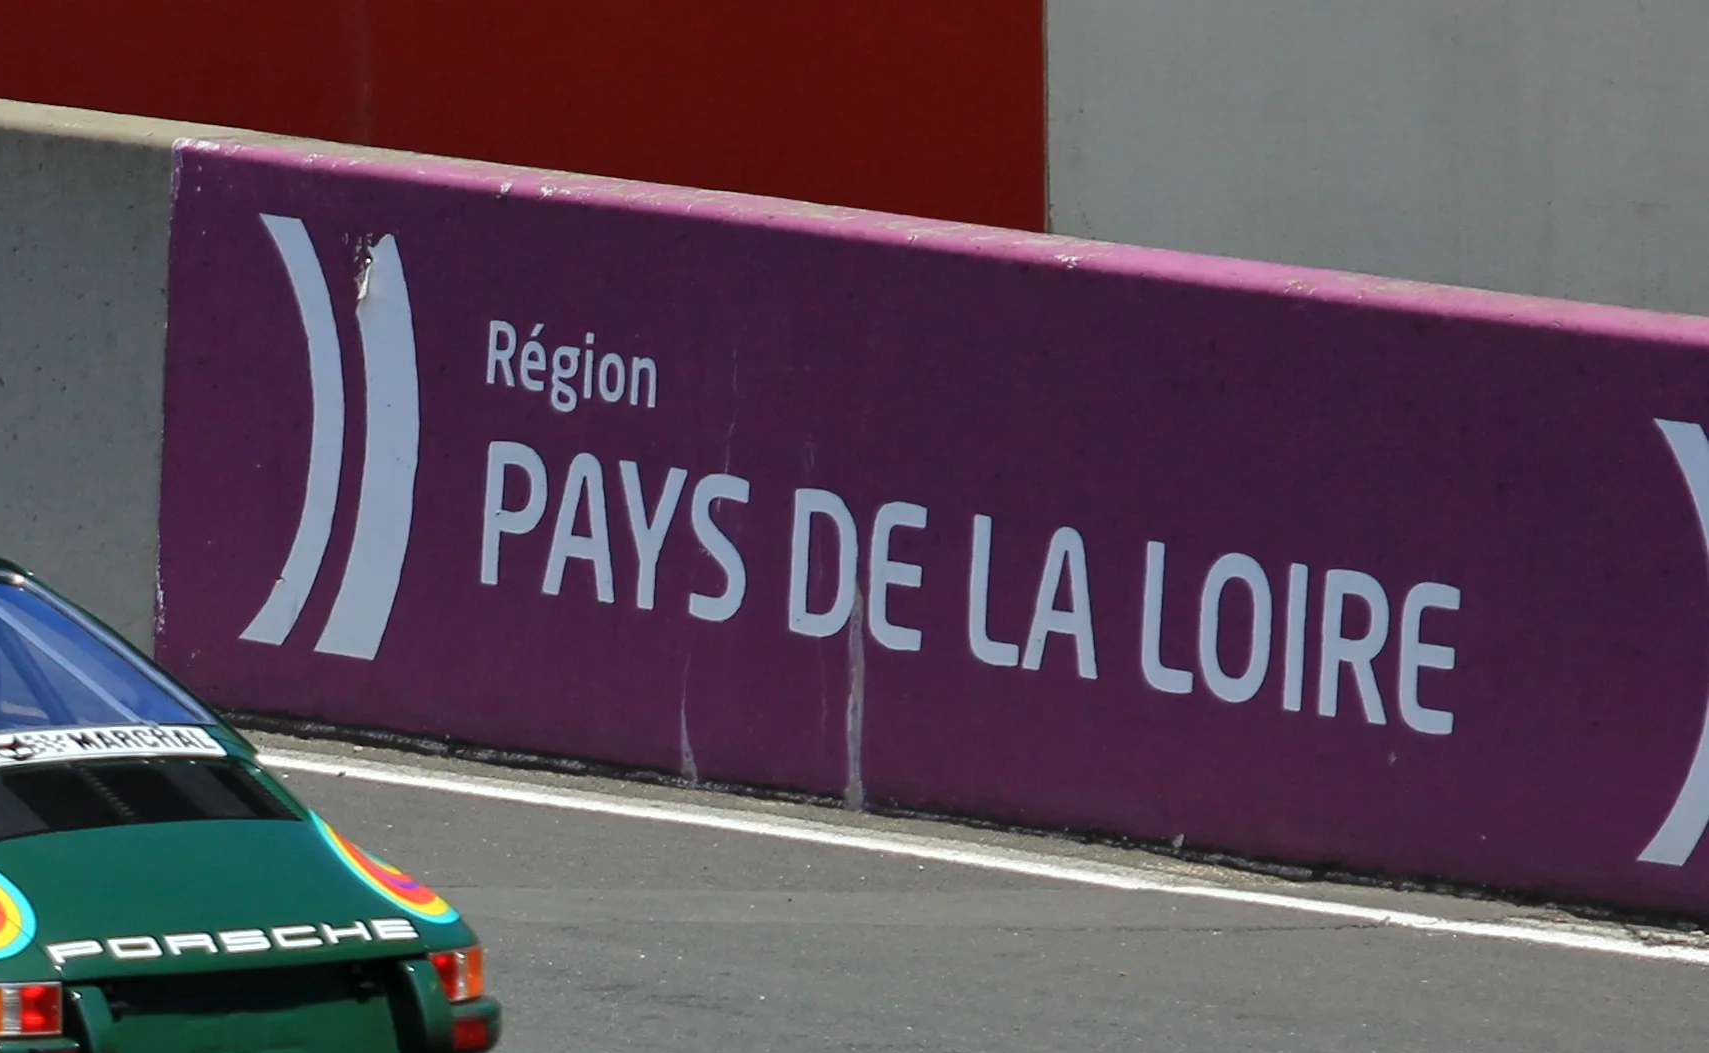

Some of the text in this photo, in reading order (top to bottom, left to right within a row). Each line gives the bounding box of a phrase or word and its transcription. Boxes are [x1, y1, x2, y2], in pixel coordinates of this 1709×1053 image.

[486, 320, 657, 412] Région
[480, 440, 1461, 735] PAYS DE LA LOIRE
[69, 726, 218, 752] MARCHAL
[46, 918, 420, 965] PORSCHE
